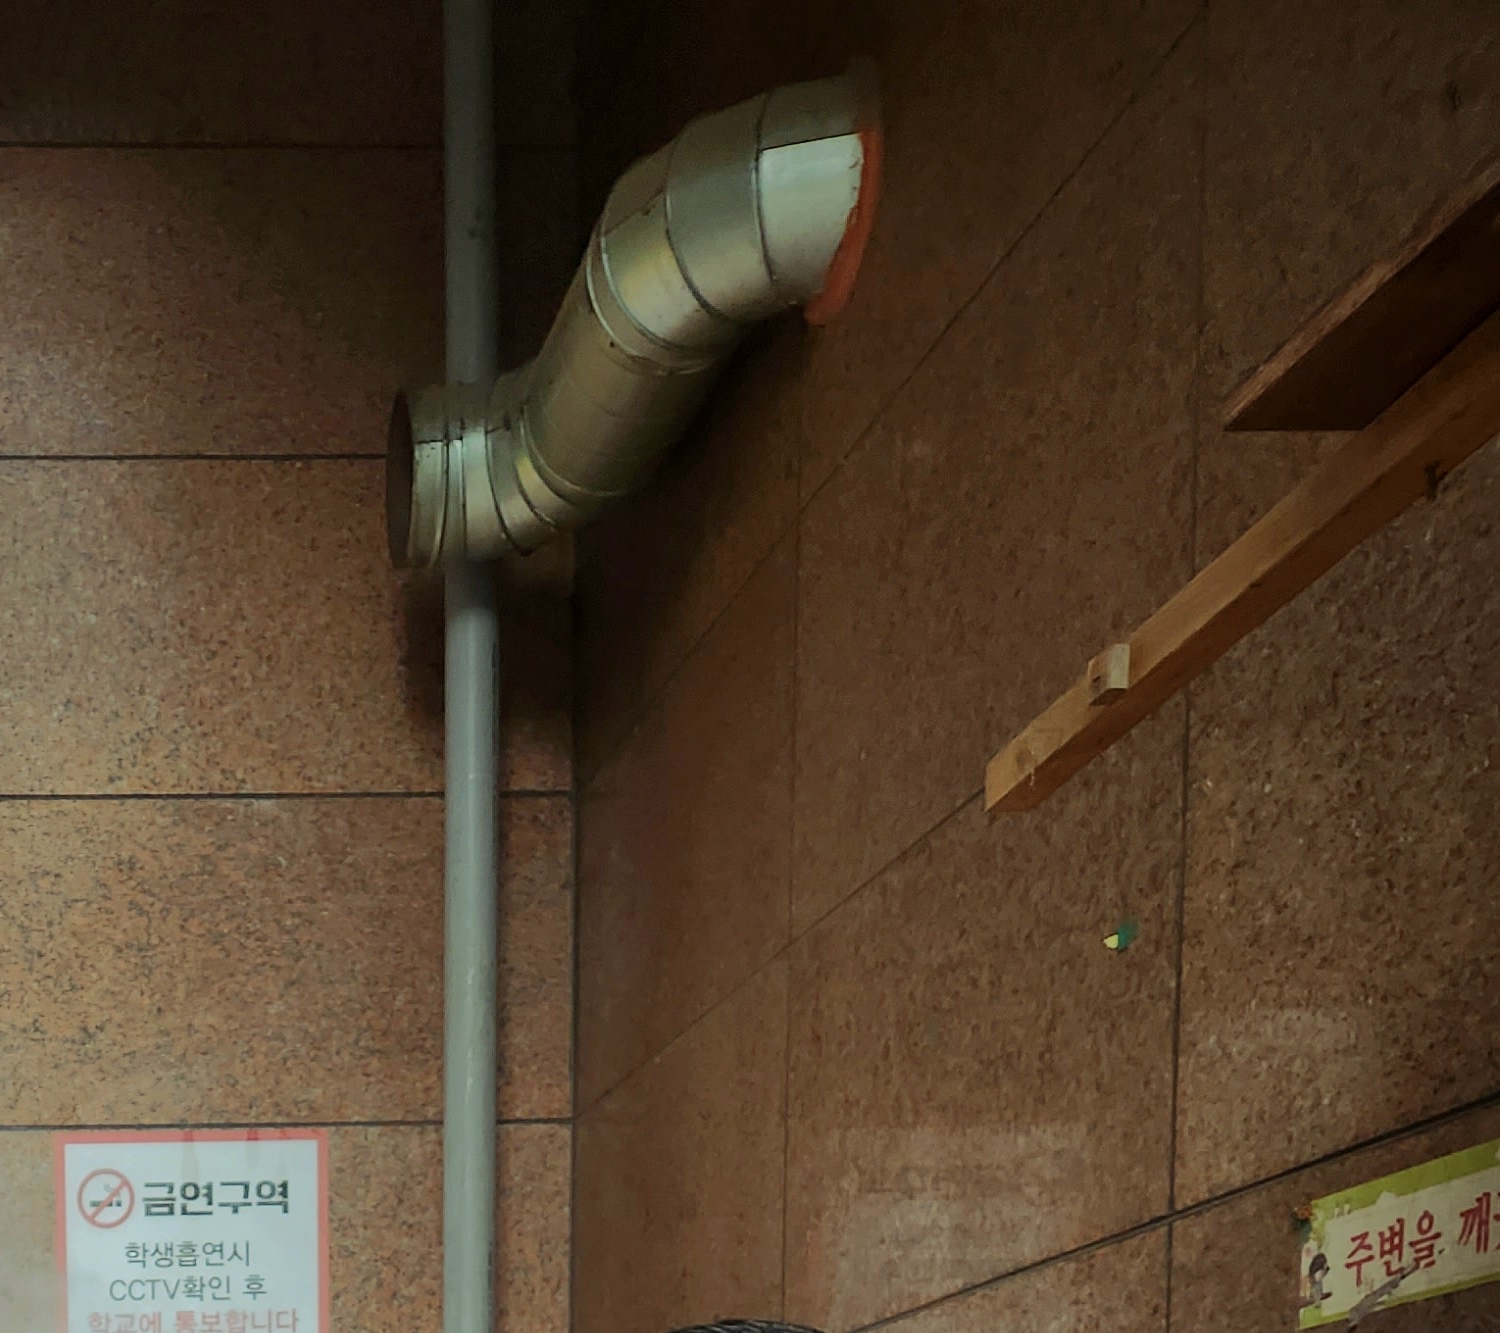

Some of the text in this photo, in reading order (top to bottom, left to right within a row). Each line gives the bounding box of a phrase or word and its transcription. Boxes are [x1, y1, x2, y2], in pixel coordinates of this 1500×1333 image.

[141, 1179, 290, 1217] 금연구역
[123, 1241, 251, 1268] 학생흡연시
[1345, 1191, 1500, 1287] 주변을 깨
[109, 1274, 268, 1302] CCTV확인 후
